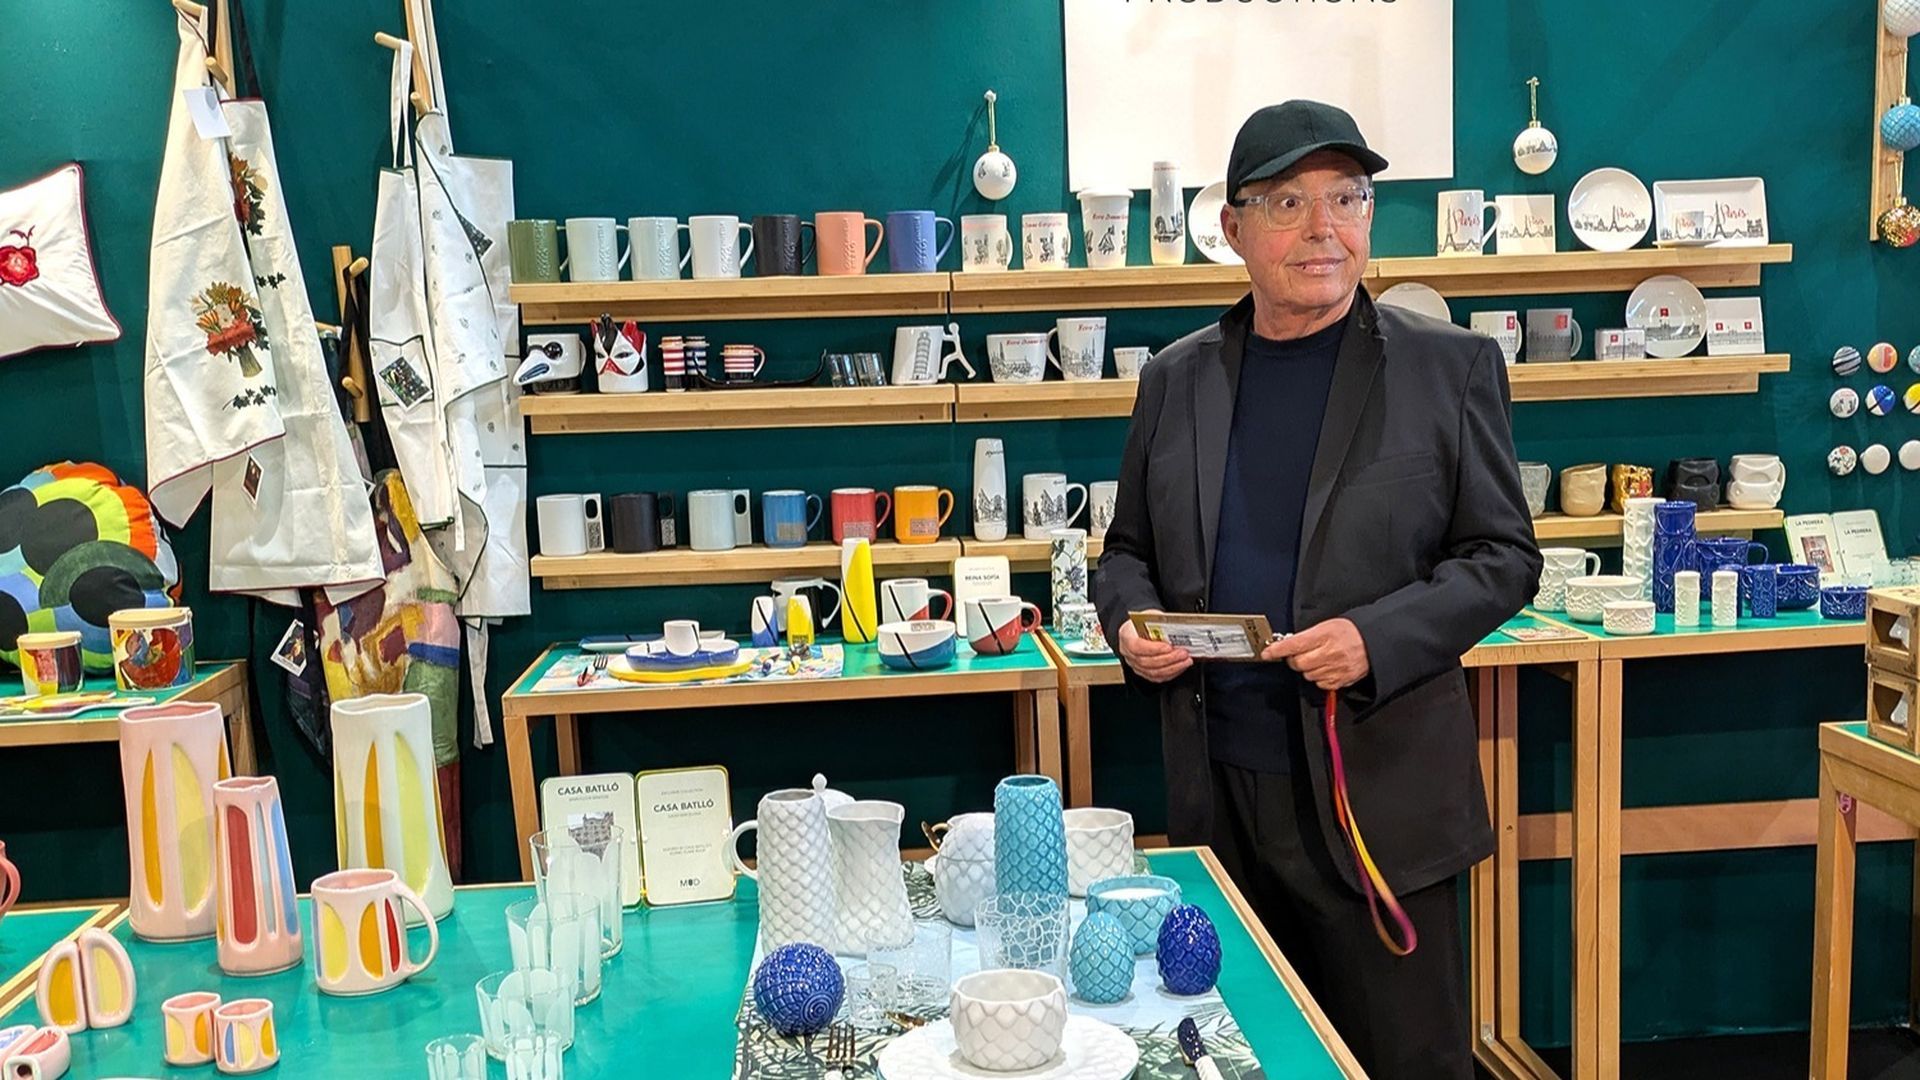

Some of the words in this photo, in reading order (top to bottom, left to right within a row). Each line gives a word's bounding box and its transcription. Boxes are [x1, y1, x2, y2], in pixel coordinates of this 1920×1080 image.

[1453, 208, 1480, 234] Paris
[1720, 203, 1747, 224] Paris
[558, 786, 584, 795] CASA
[585, 782, 619, 793] BATLLÓ
[653, 804, 679, 813] CASA
[680, 799, 714, 810] BATLLÓ
